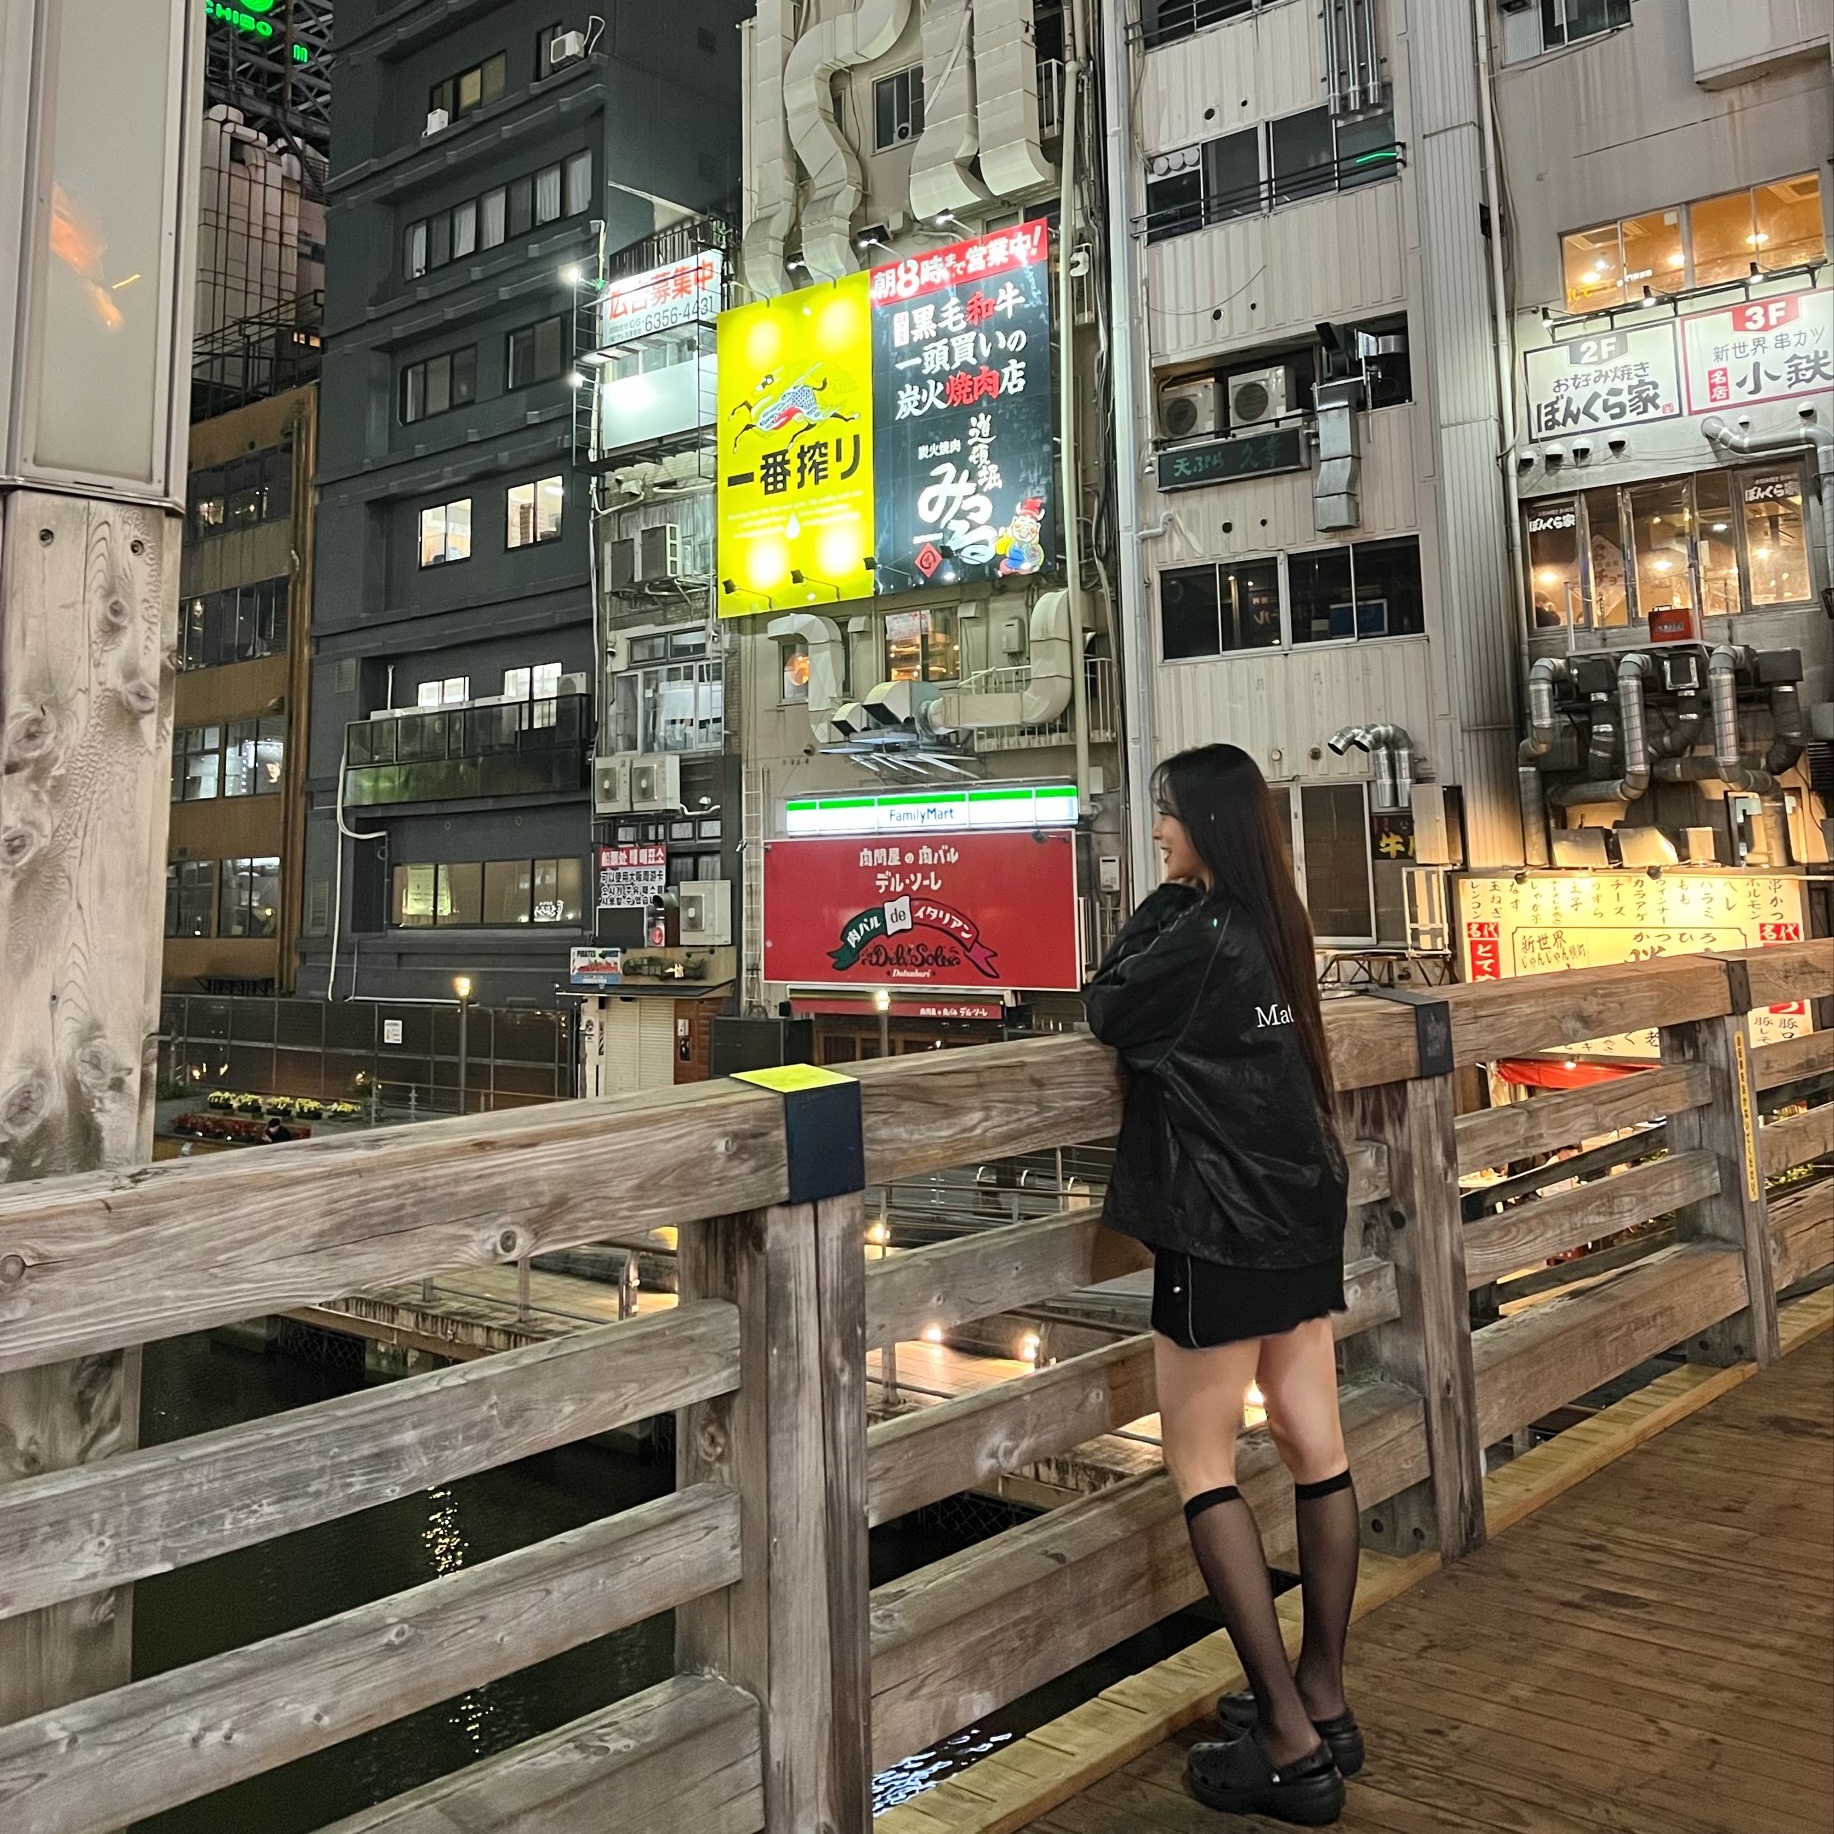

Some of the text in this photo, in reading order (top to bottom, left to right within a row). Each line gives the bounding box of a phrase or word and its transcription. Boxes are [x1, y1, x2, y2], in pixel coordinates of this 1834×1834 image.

[872, 226, 1042, 297] 朝8時まで営業中!
[911, 281, 1026, 343] 黒毛和牛
[1744, 301, 1787, 330] 3F
[895, 330, 1027, 375] 一頭買いの
[1579, 336, 1617, 364] 2F
[1713, 326, 1825, 363] 新世界 串カツ
[895, 359, 1027, 420] 炭火焼肉店
[1553, 361, 1650, 393] お好み焼き
[1710, 370, 1728, 399] 名店
[1537, 379, 1661, 433] ぼんくら家
[727, 434, 860, 495] 一番搾り
[967, 412, 1003, 492] 道頓堀
[1173, 451, 1225, 477] 天ぷら
[889, 806, 955, 824] FamilyMart
[1470, 880, 1482, 920] レンコン
[1678, 878, 1691, 905] もも
[1745, 879, 1762, 920] ホルモン
[1768, 879, 1785, 921] 串かつ
[847, 906, 973, 948] 肉バル de イタリアン
[1468, 923, 1498, 938] 名代
[1521, 930, 1567, 954] 新世界
[1632, 931, 1717, 944] かつひろ
[1760, 924, 1799, 941] 名代
